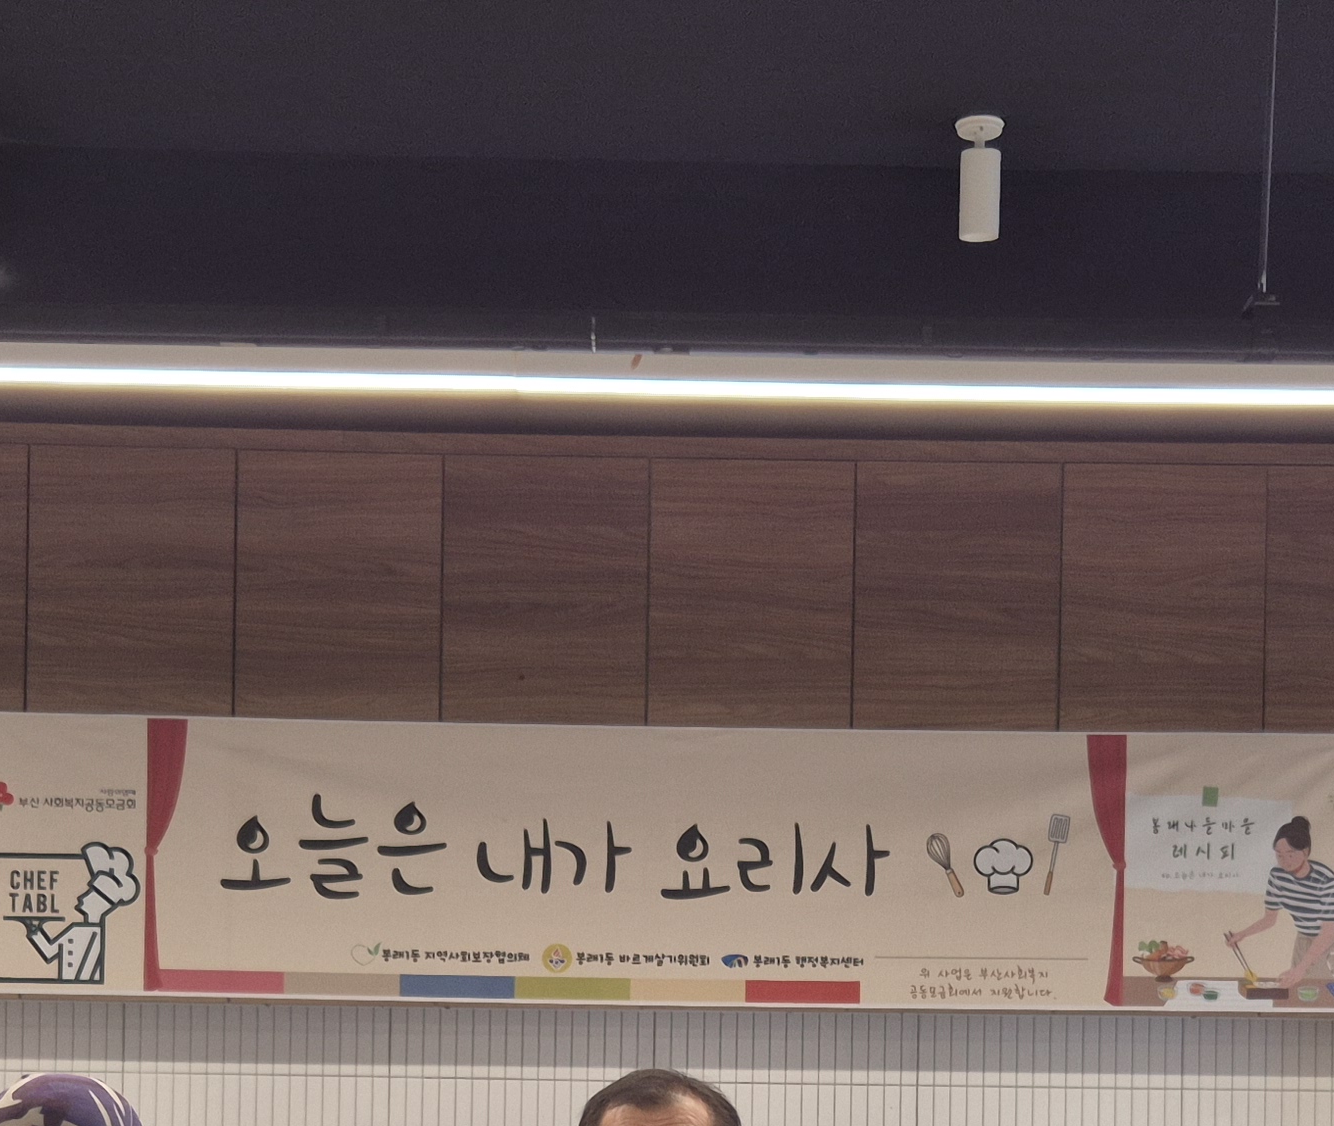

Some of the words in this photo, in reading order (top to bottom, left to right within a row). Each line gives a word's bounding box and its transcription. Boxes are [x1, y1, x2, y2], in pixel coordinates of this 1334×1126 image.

[18, 797, 40, 809] 부산
[43, 796, 137, 813] 사회복지공동모금회
[219, 793, 448, 900] 오늘은
[476, 817, 632, 894] 내가
[660, 822, 891, 900] 요리사
[1172, 842, 1235, 860] 레시피
[9, 869, 60, 891] CHEF
[8, 892, 60, 914] TABL
[381, 948, 421, 963] 봉래1동
[424, 950, 530, 965] 지역사회보장협의체
[576, 951, 615, 966] 봉래1동
[618, 953, 710, 968] 바르게살기위원회
[753, 954, 791, 969] 봉래1동
[794, 955, 864, 969] 행정복지센터
[919, 967, 931, 979] 위
[937, 967, 972, 982] 사업은
[979, 964, 1049, 986] 부산사회복지
[909, 982, 983, 1000] 공동모금회에서
[990, 980, 1057, 1000] 지원합니다.
